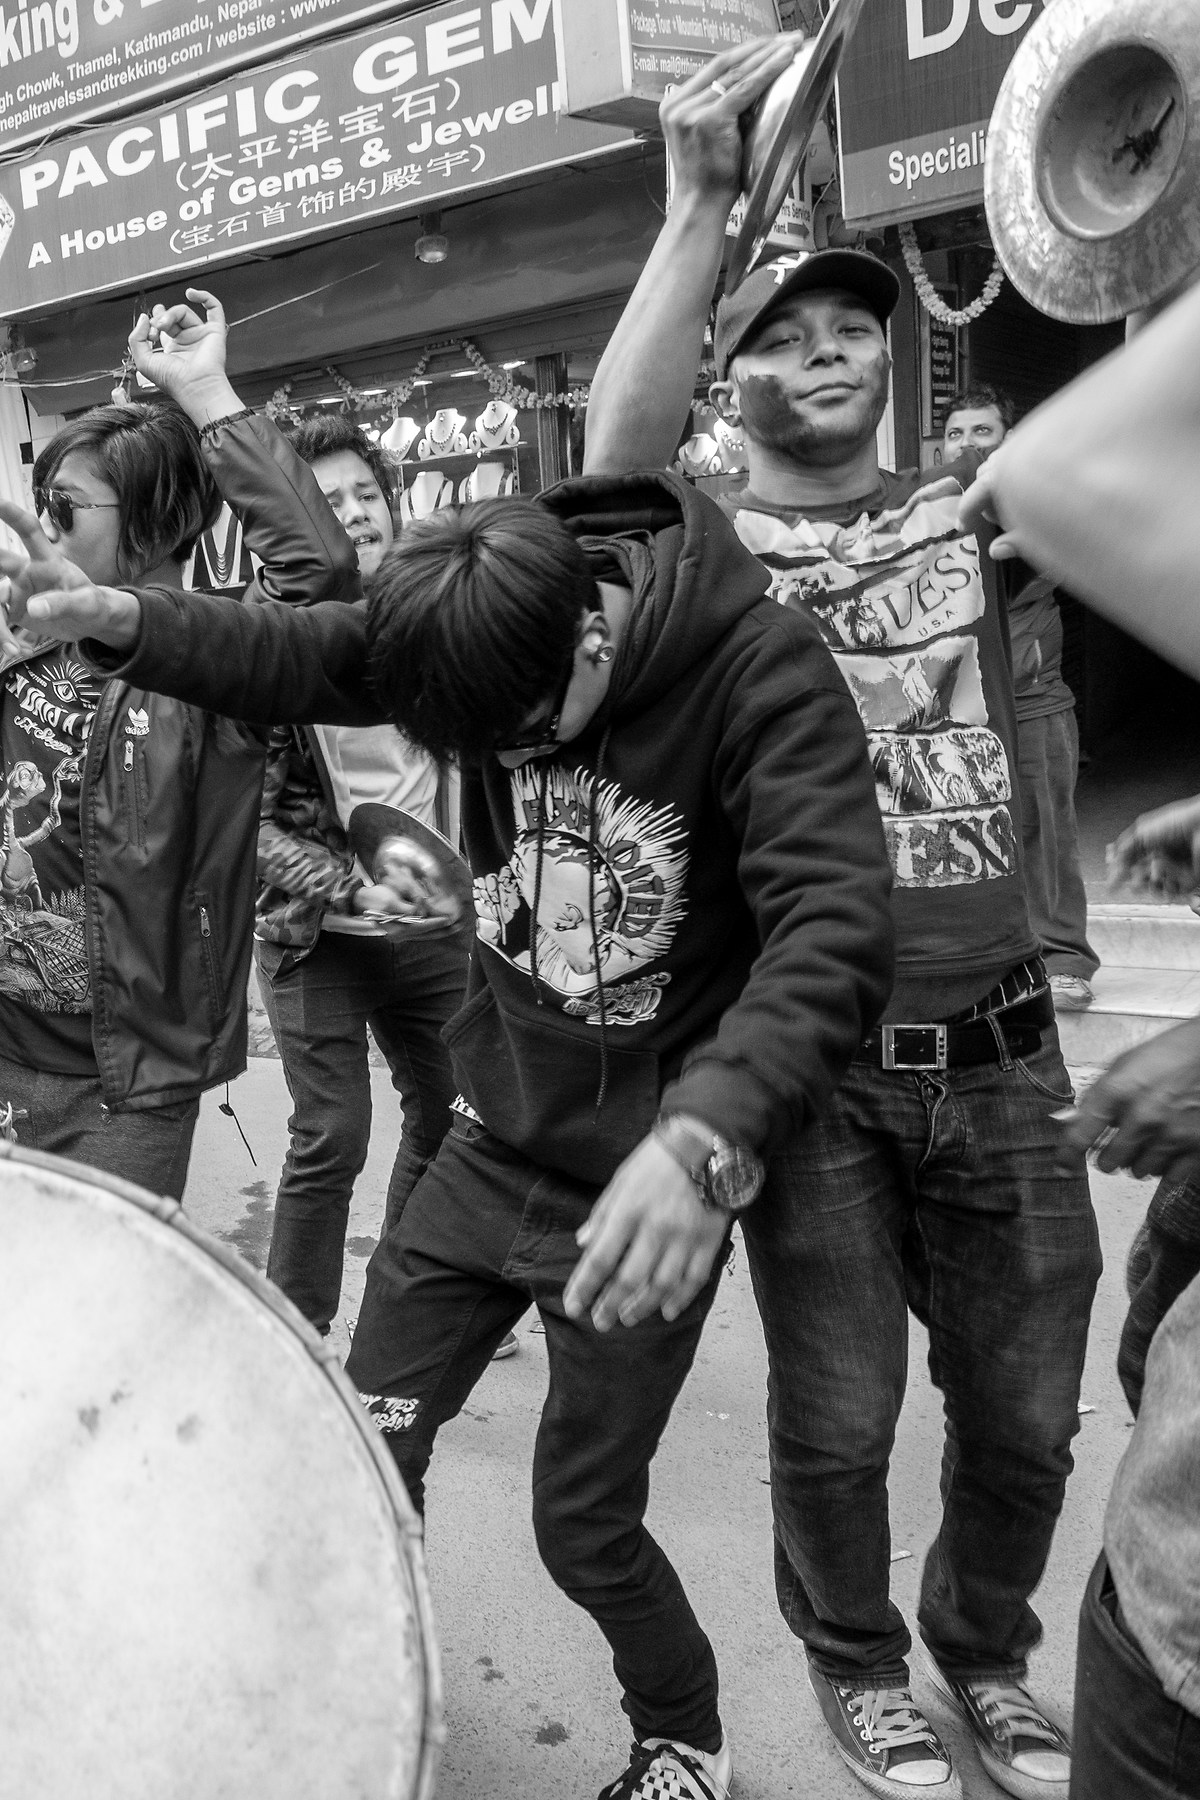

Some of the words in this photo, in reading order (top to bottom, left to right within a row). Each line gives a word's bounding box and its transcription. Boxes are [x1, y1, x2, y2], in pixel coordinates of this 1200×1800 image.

[16, 72, 64, 103] Chowk,
[67, 47, 122, 81] Thamel,
[125, 14, 214, 59] Kathmandu,
[215, 13, 276, 48] website
[19, 69, 321, 210] PACIFIC
[352, 0, 552, 94] GEM
[28, 241, 52, 269] A
[60, 210, 168, 259] House
[179, 187, 215, 222] of
[229, 156, 344, 206] Gems
[359, 137, 392, 169] &
[407, 81, 560, 154] Jewell
